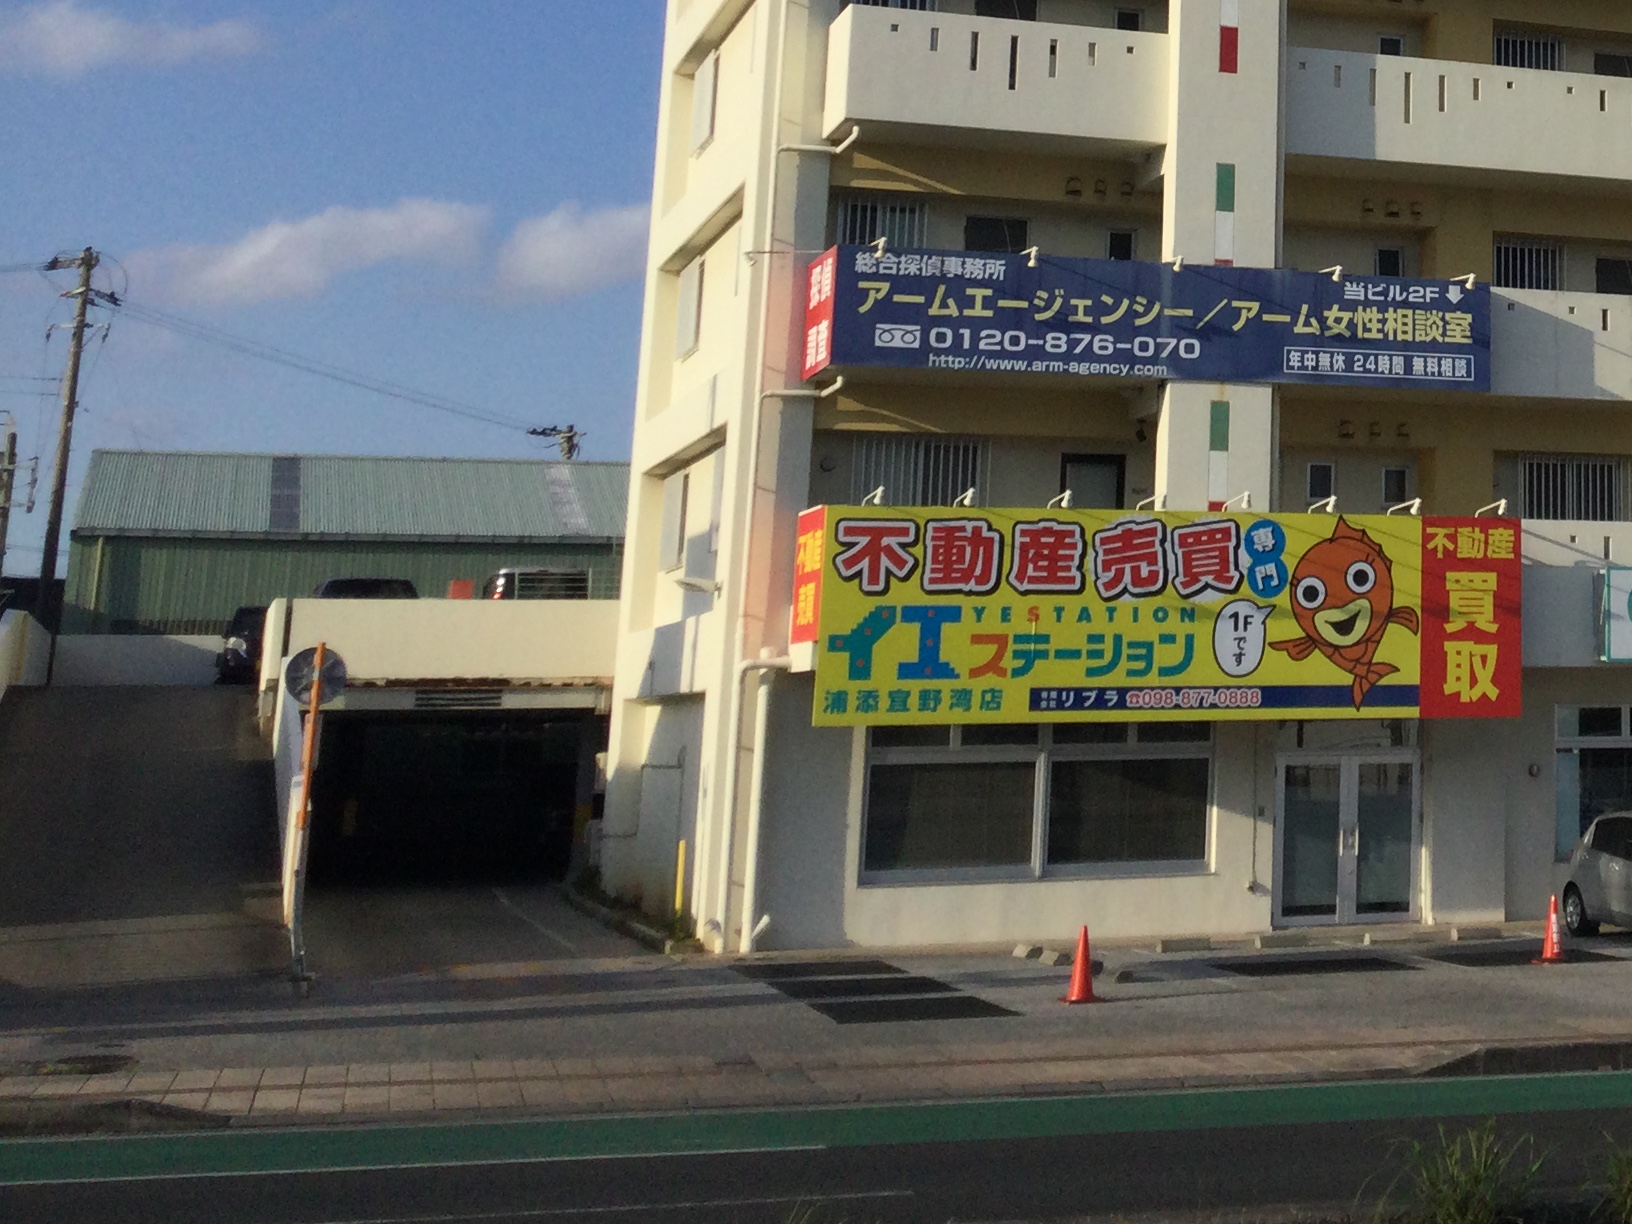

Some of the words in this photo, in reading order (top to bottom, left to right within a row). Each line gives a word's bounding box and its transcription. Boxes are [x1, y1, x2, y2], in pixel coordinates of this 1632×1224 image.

[855, 252, 1006, 281] 総合探偵事務所
[1344, 281, 1440, 303] 当ビル2F
[929, 327, 1201, 359] 0120-876-070
[928, 353, 1167, 377] http://www.arm-agency.com
[1426, 526, 1515, 559] 不動産
[833, 518, 1243, 602] 不動産売買
[1253, 526, 1279, 590] 専門
[1228, 611, 1253, 633] 1F
[1443, 571, 1499, 703] 買取
[1233, 635, 1247, 666] です
[823, 688, 1004, 714] 浦添宜野湾店
[1142, 689, 1261, 709] 098-877-0888
